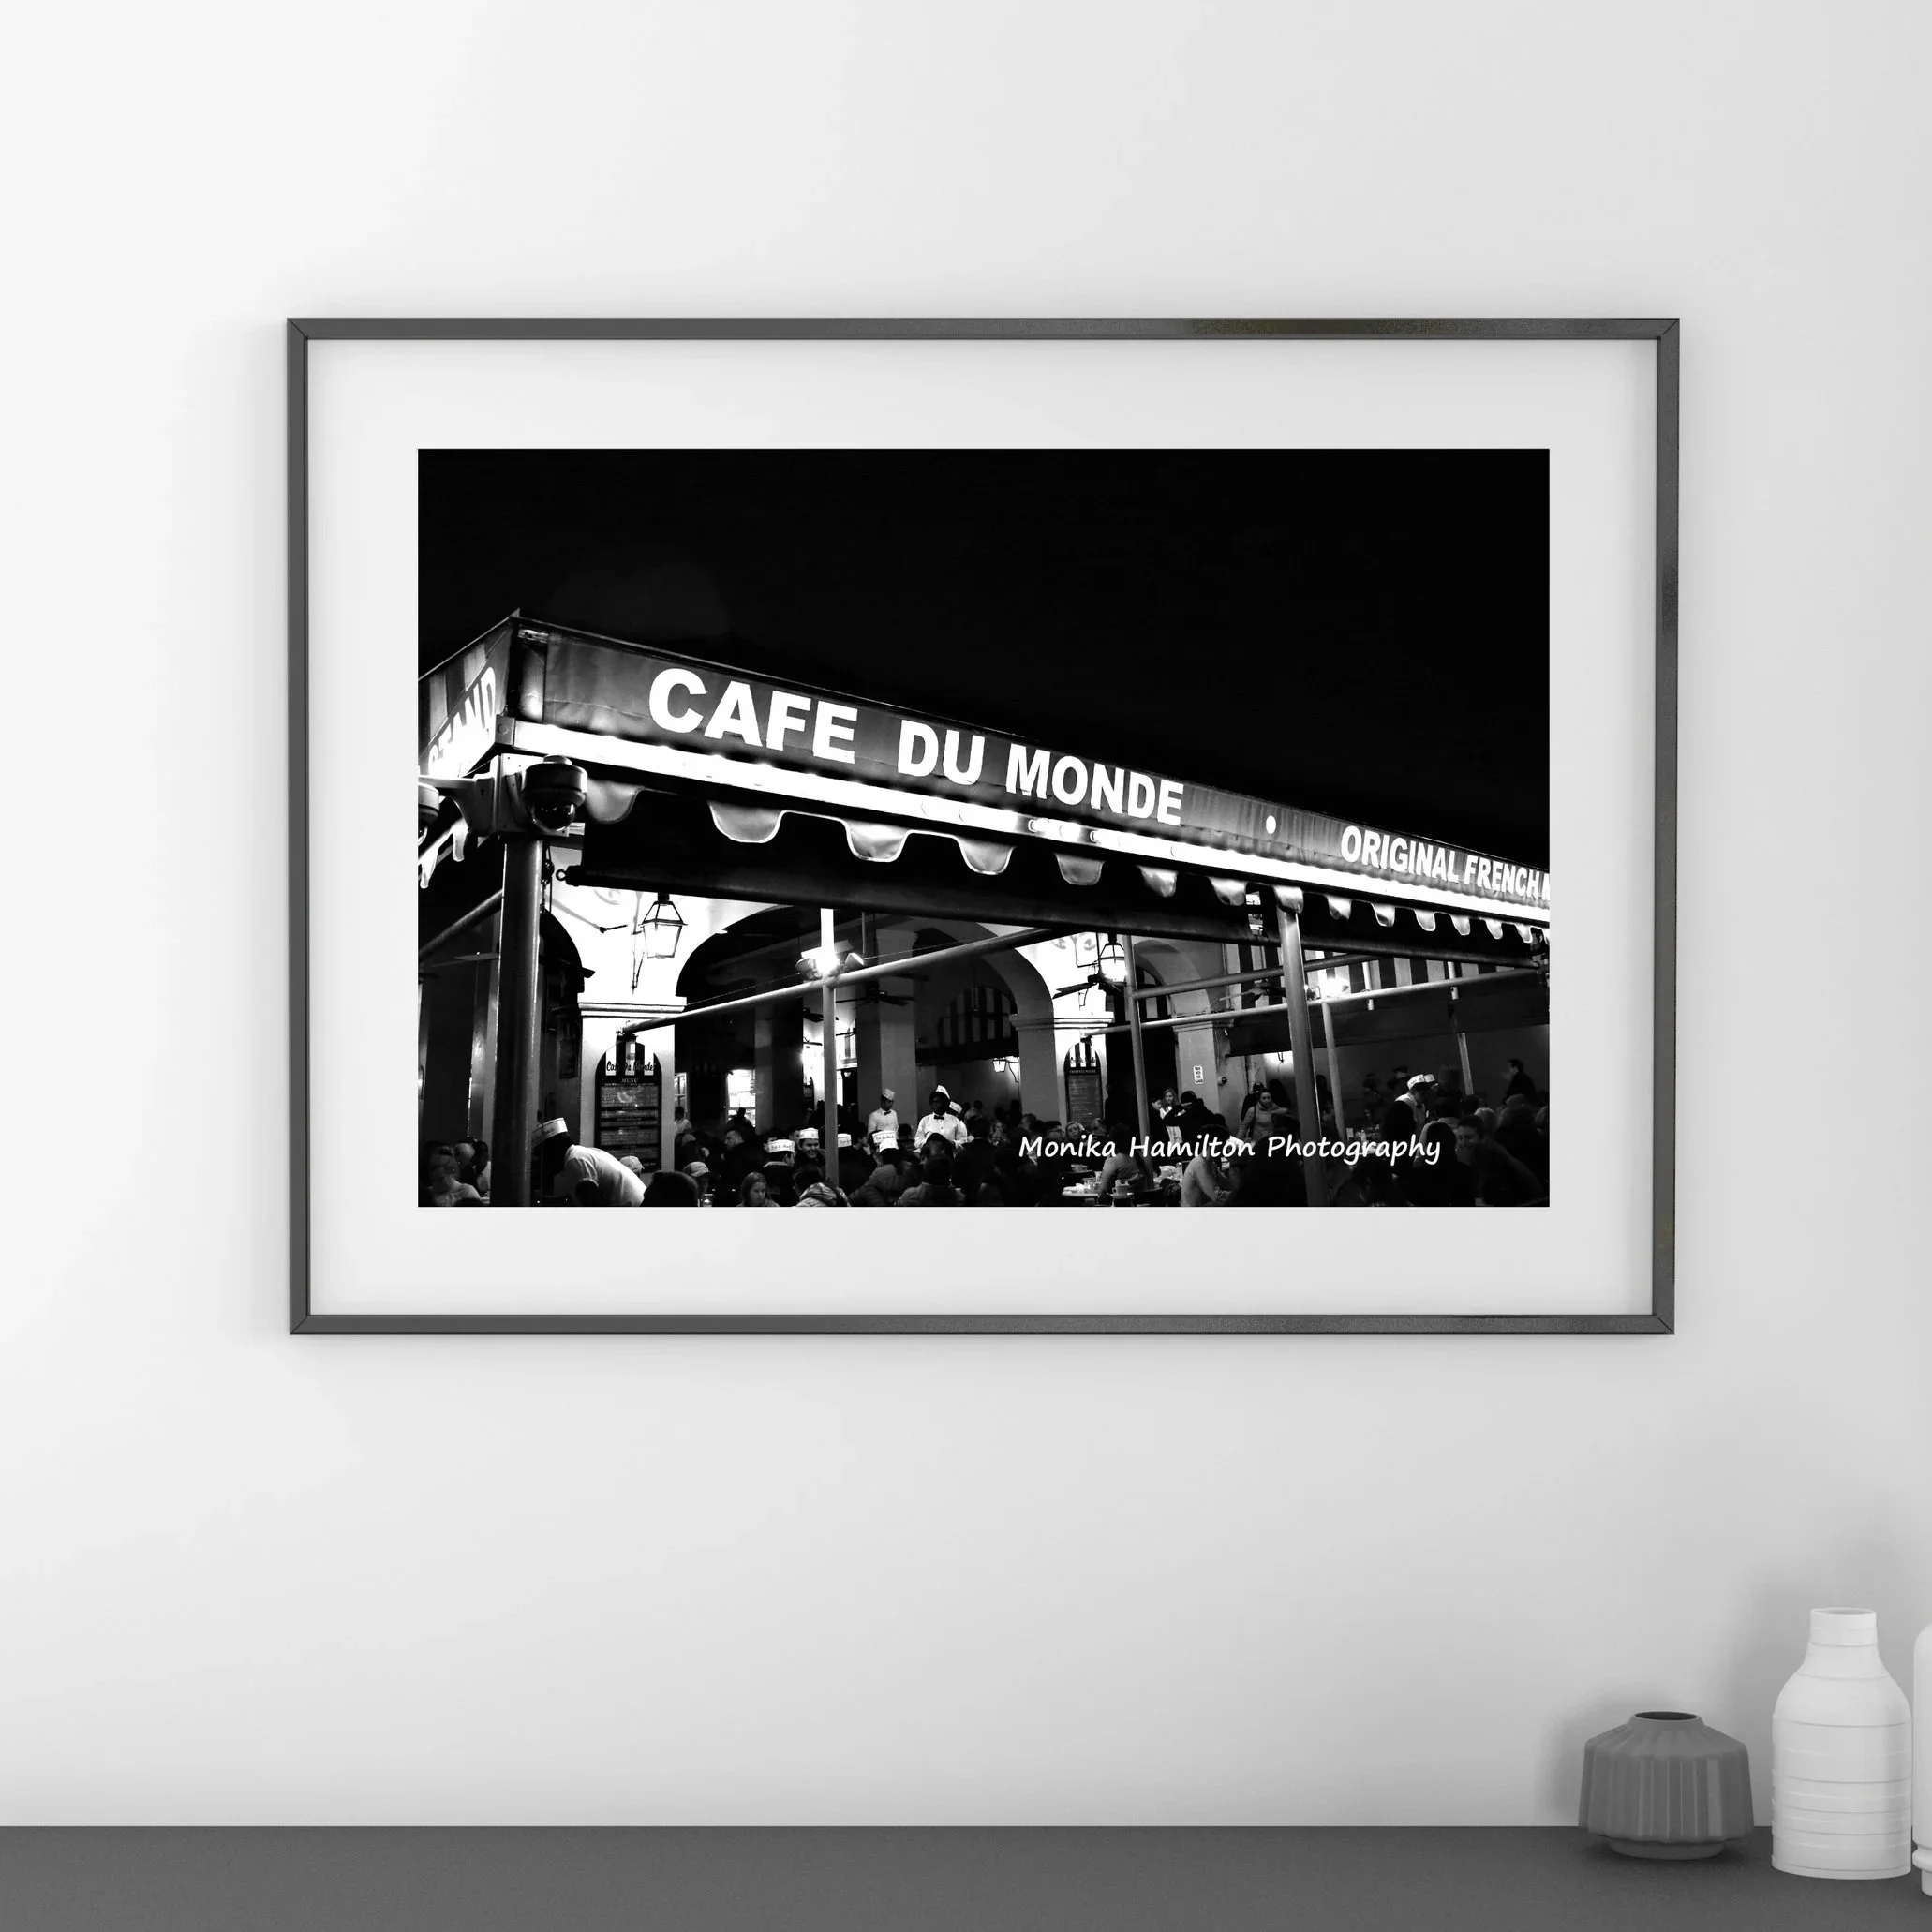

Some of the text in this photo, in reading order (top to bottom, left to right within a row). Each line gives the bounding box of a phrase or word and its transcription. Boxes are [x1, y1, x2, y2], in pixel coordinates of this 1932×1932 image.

[648, 667, 1185, 826] CAFE DU MONDE
[1340, 825, 1461, 884] ORIGINAL
[1464, 854, 1540, 899] FRENCH
